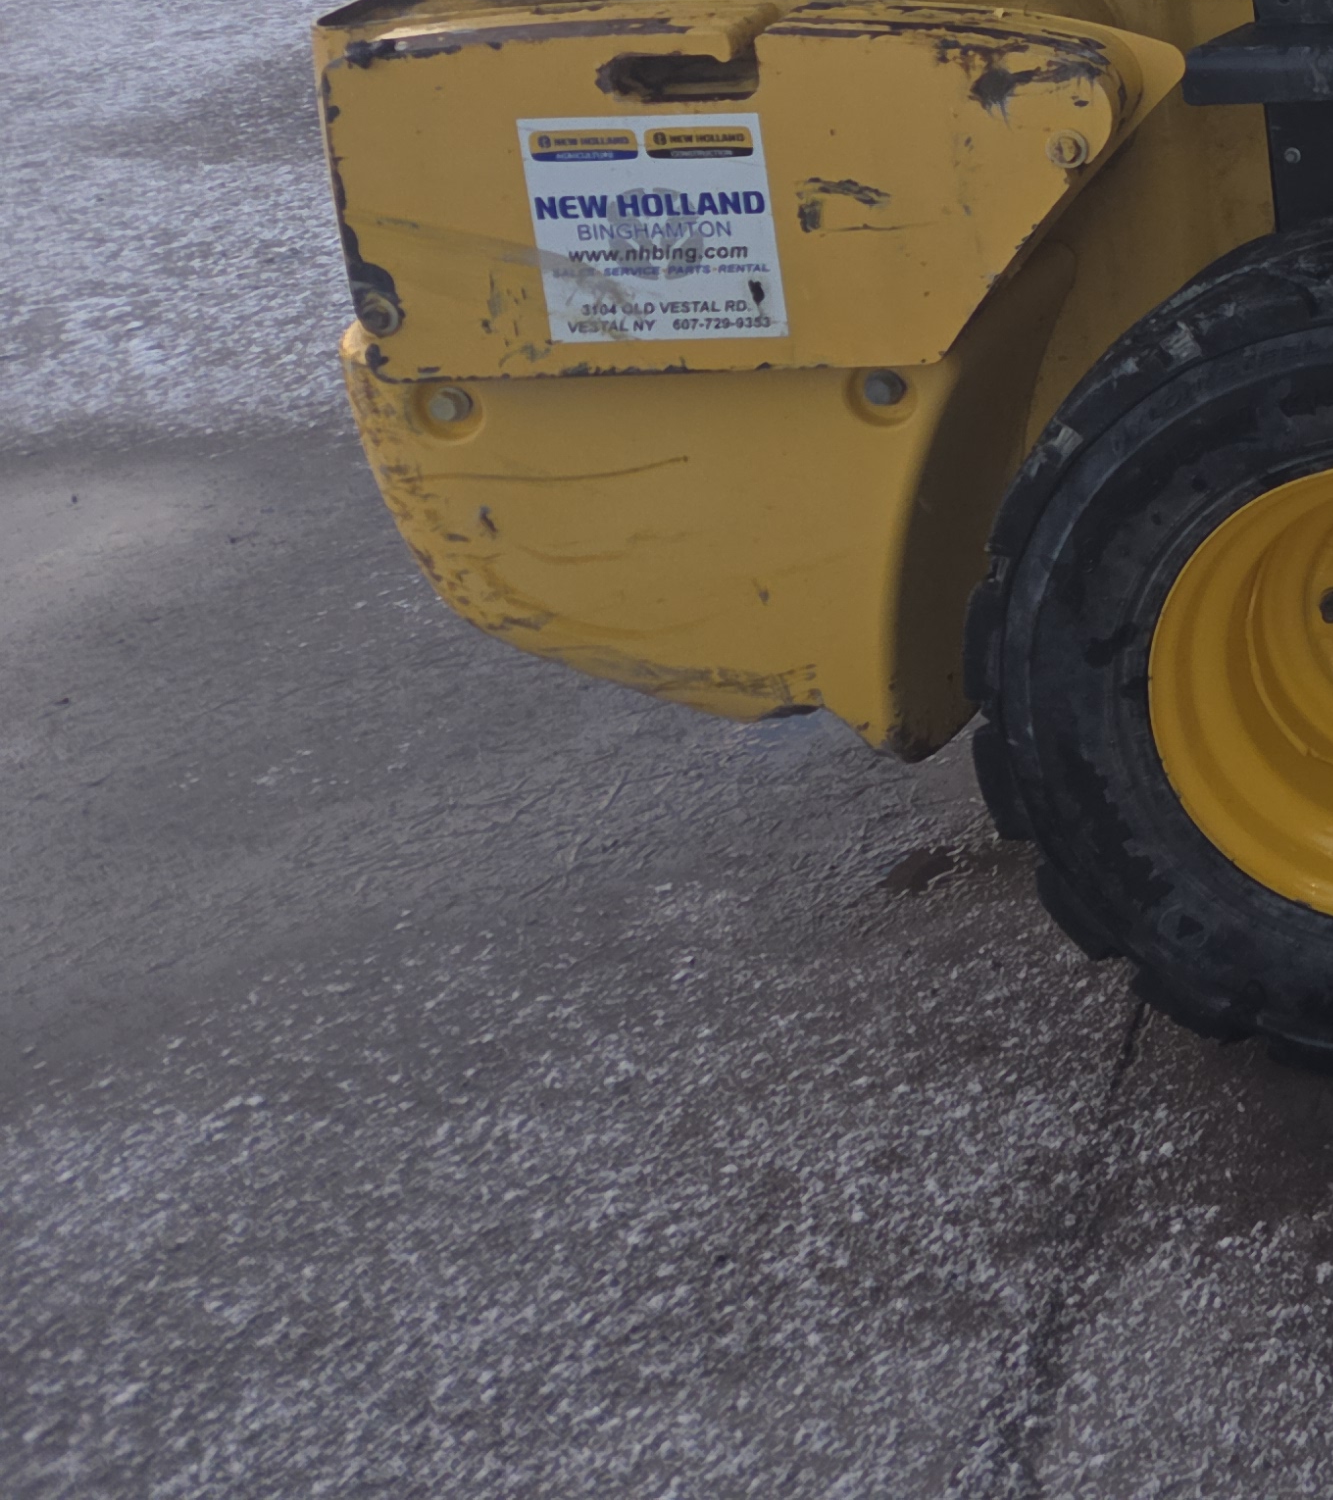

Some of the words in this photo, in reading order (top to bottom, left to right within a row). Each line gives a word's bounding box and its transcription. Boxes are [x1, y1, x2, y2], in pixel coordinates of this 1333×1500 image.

[669, 134, 694, 143] NEW
[696, 132, 745, 143] HOLLAND
[534, 195, 608, 221] NEW
[616, 190, 766, 218] HOLLAND
[576, 220, 733, 242] BINGHAMTON
[568, 245, 749, 264] www.nhbing.com
[580, 303, 617, 317] 3104
[621, 301, 656, 316] OLD
[659, 300, 721, 315] VESTAL
[567, 318, 629, 334] VESTAL
[632, 318, 658, 332] NY
